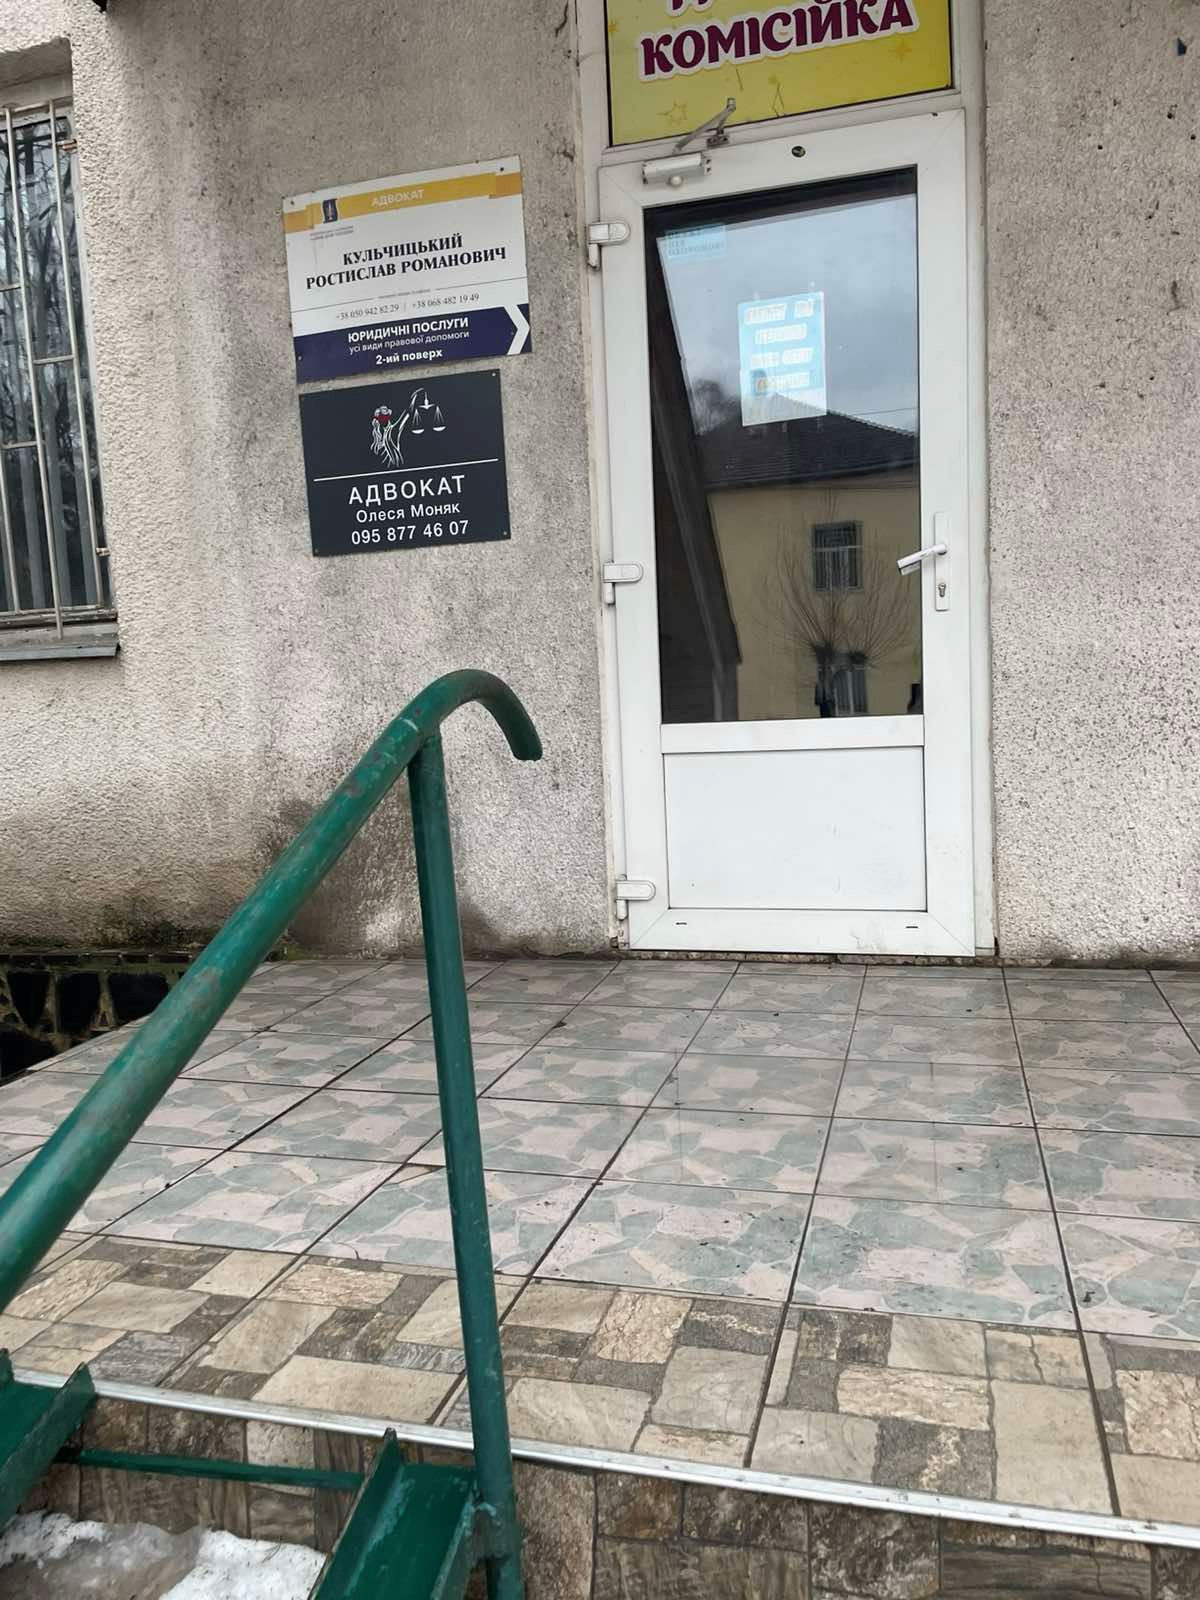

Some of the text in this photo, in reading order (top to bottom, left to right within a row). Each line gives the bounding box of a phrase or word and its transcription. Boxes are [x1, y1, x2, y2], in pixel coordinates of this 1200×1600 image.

[640, 0, 914, 76] КОМІСІЙКА
[371, 189, 425, 207] АДВОКАТ
[343, 233, 463, 266] КУЛЬЧИЦЬКИЙ
[306, 247, 507, 290] РОСТИСЛАВ РОМАНОВИЧ
[444, 296, 457, 305] 482
[460, 294, 468, 302] 19
[470, 293, 479, 301] 49
[348, 316, 469, 343] ЮРИДИЧНІ ПОСЛУГИ
[349, 331, 470, 354] усі види правової допомоги
[376, 348, 443, 365] 2-ий поверх
[349, 475, 465, 506] АДВОКАТ
[356, 502, 460, 524] Олеся Моняк
[351, 520, 468, 545] 095 877 46 07
